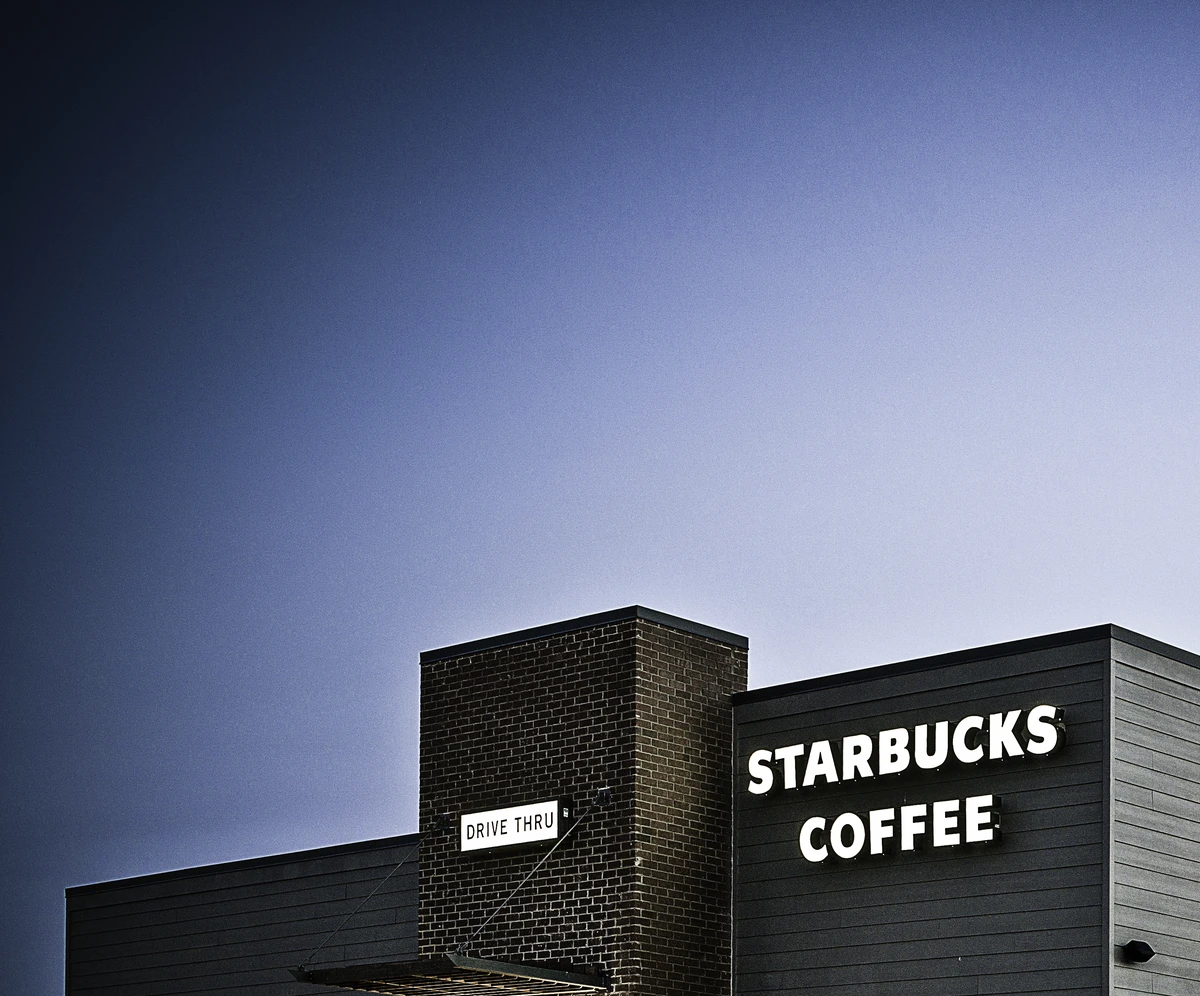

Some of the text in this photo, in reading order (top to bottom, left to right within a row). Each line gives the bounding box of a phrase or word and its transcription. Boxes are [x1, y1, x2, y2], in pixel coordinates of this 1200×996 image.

[747, 703, 1060, 795] STARBUCKS
[466, 811, 554, 840] DRIVE THRU
[798, 793, 995, 863] COFFEE
